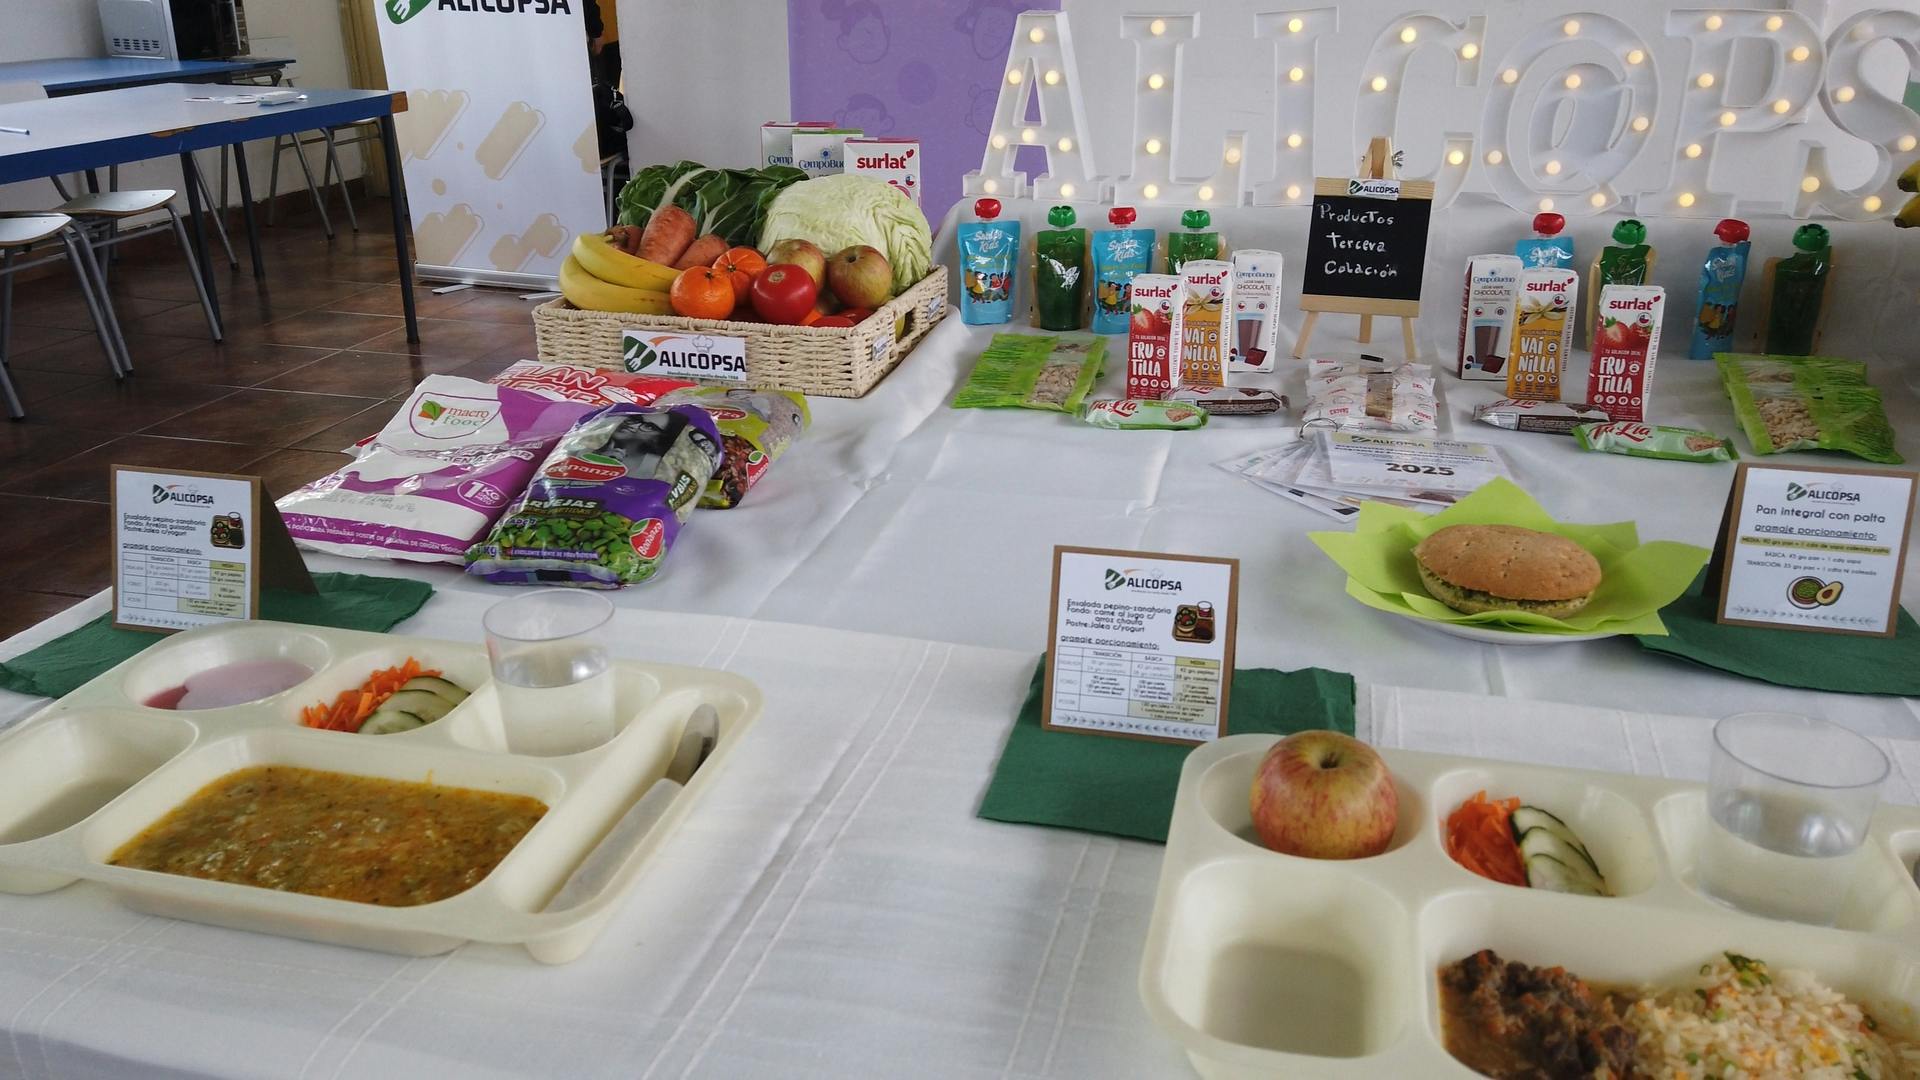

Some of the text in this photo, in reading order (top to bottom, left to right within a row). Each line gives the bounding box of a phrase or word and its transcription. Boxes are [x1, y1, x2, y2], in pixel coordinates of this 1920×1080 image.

[856, 153, 907, 169] surlat
[1363, 185, 1399, 194] ALICOPSA
[1135, 286, 1171, 298] surlat
[1526, 280, 1566, 292] surlat
[1609, 298, 1653, 311] surlat
[1132, 342, 1154, 359] FRU
[659, 350, 746, 372] ALICOPSA
[1600, 357, 1626, 375] FRU
[448, 407, 490, 418] macro
[1372, 439, 1425, 448] ALICOPSA
[1385, 463, 1455, 476] 2025
[170, 493, 214, 505] ALICOPSA
[1807, 490, 1861, 502] ALICOPSA
[1756, 504, 1886, 523] Pan integral con palta
[637, 522, 661, 555] Bonanza
[1755, 523, 1877, 541] gramaje porcionamiento:
[1127, 577, 1182, 591] ALICOPSA
[1067, 598, 1101, 608] Ensalada
[1127, 611, 1144, 620] jugo
[1060, 635, 1160, 651] gramaje porcionamiento:
